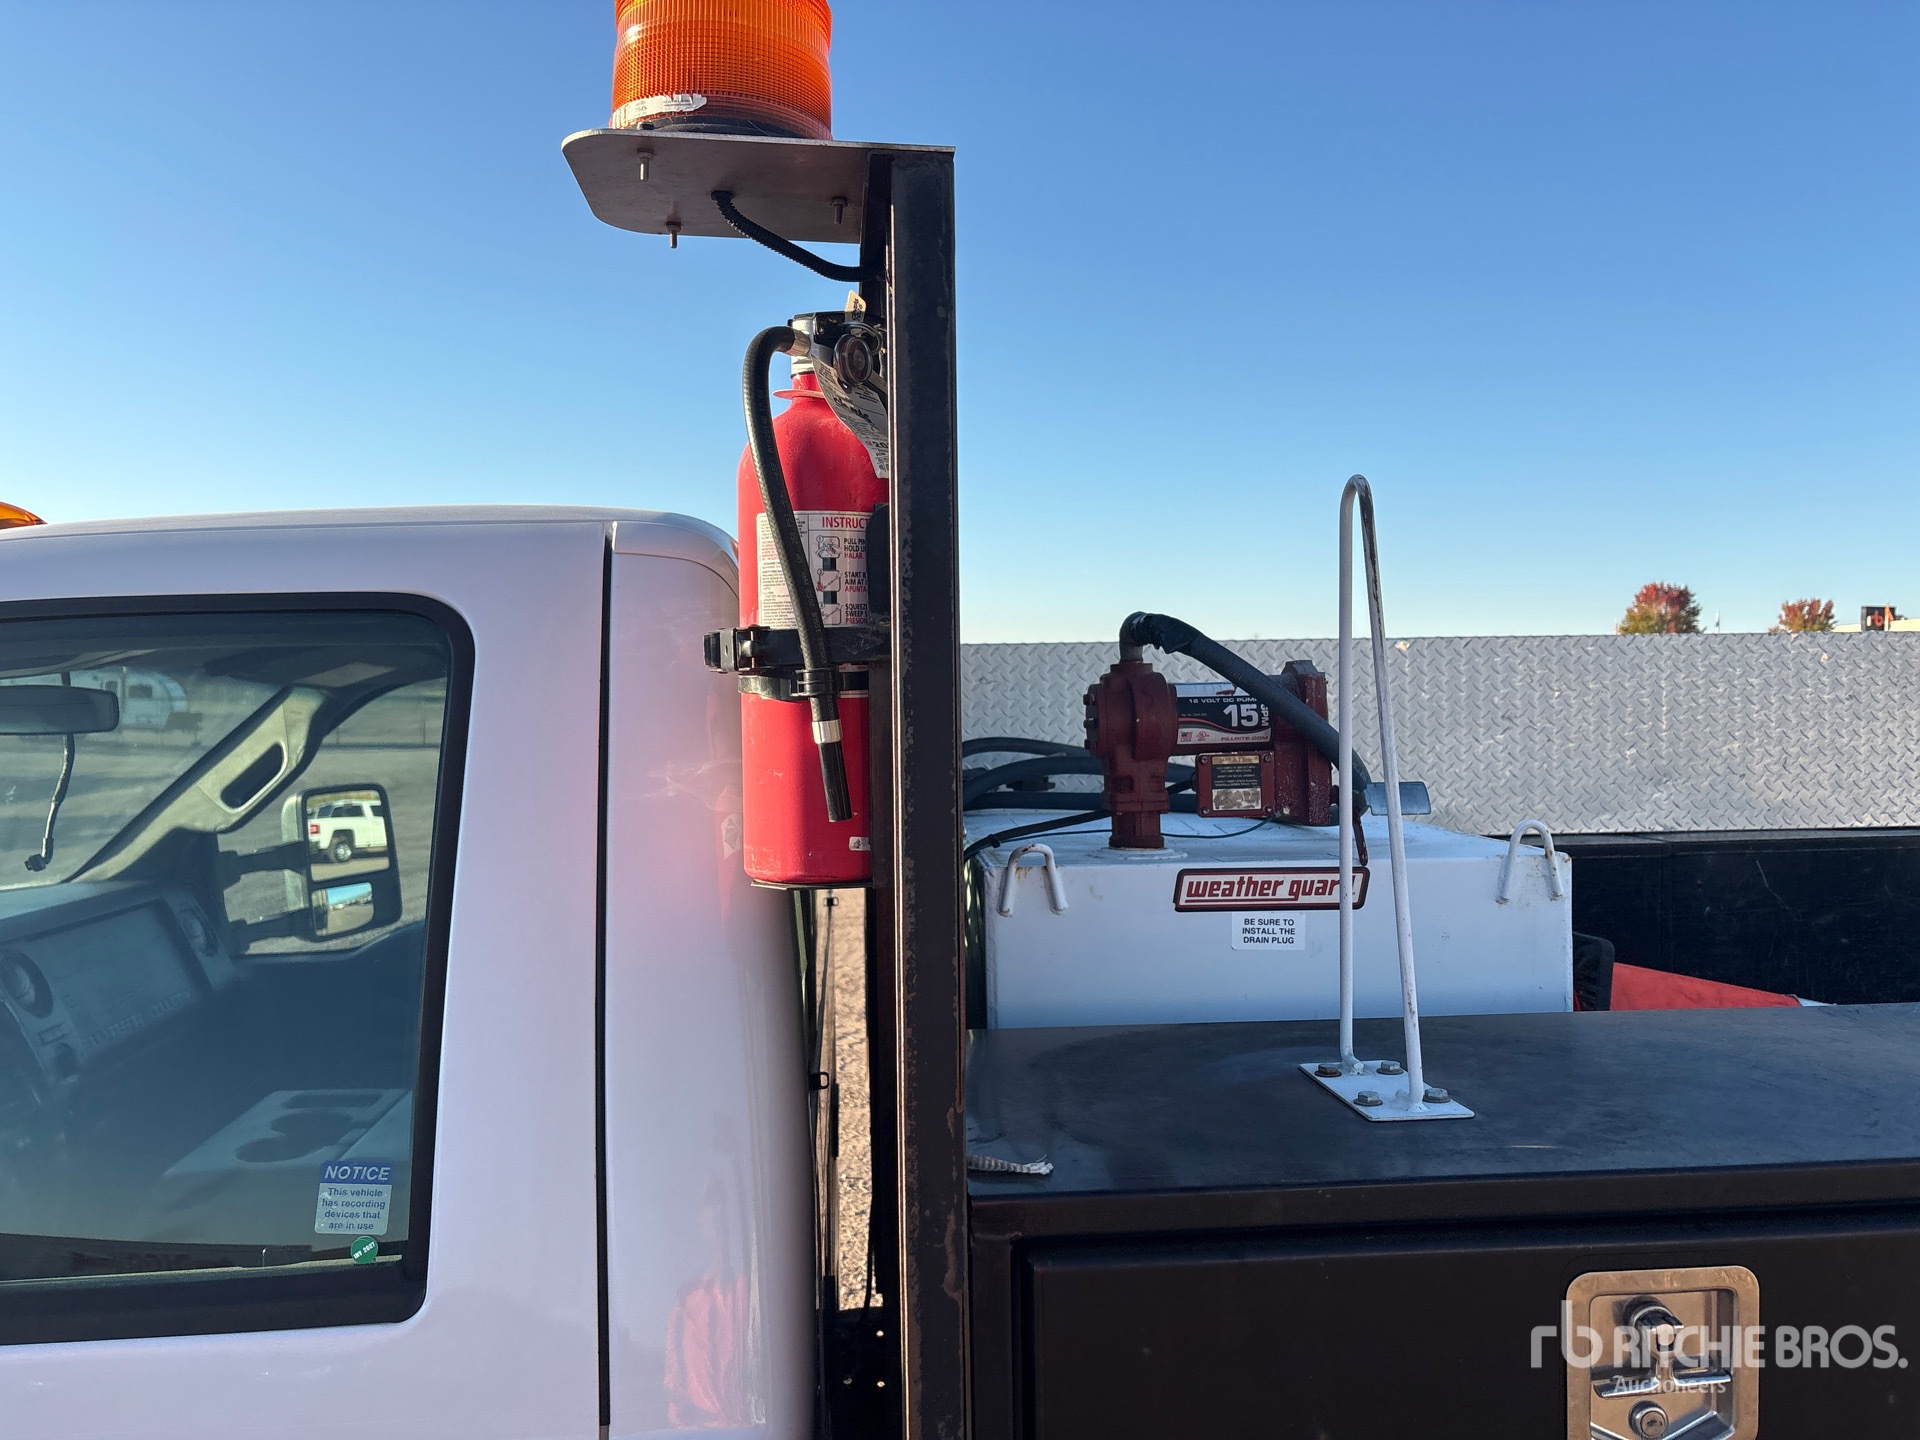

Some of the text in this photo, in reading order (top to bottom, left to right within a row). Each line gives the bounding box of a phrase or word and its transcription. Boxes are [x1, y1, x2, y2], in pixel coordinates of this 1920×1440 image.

[1223, 704, 1269, 727] 15 GPM
[1186, 875, 1356, 901] weather guar
[324, 1166, 391, 1180] NOTICE
[328, 1188, 348, 1196] This
[322, 1198, 385, 1209] has recording
[325, 1210, 360, 1218] devices
